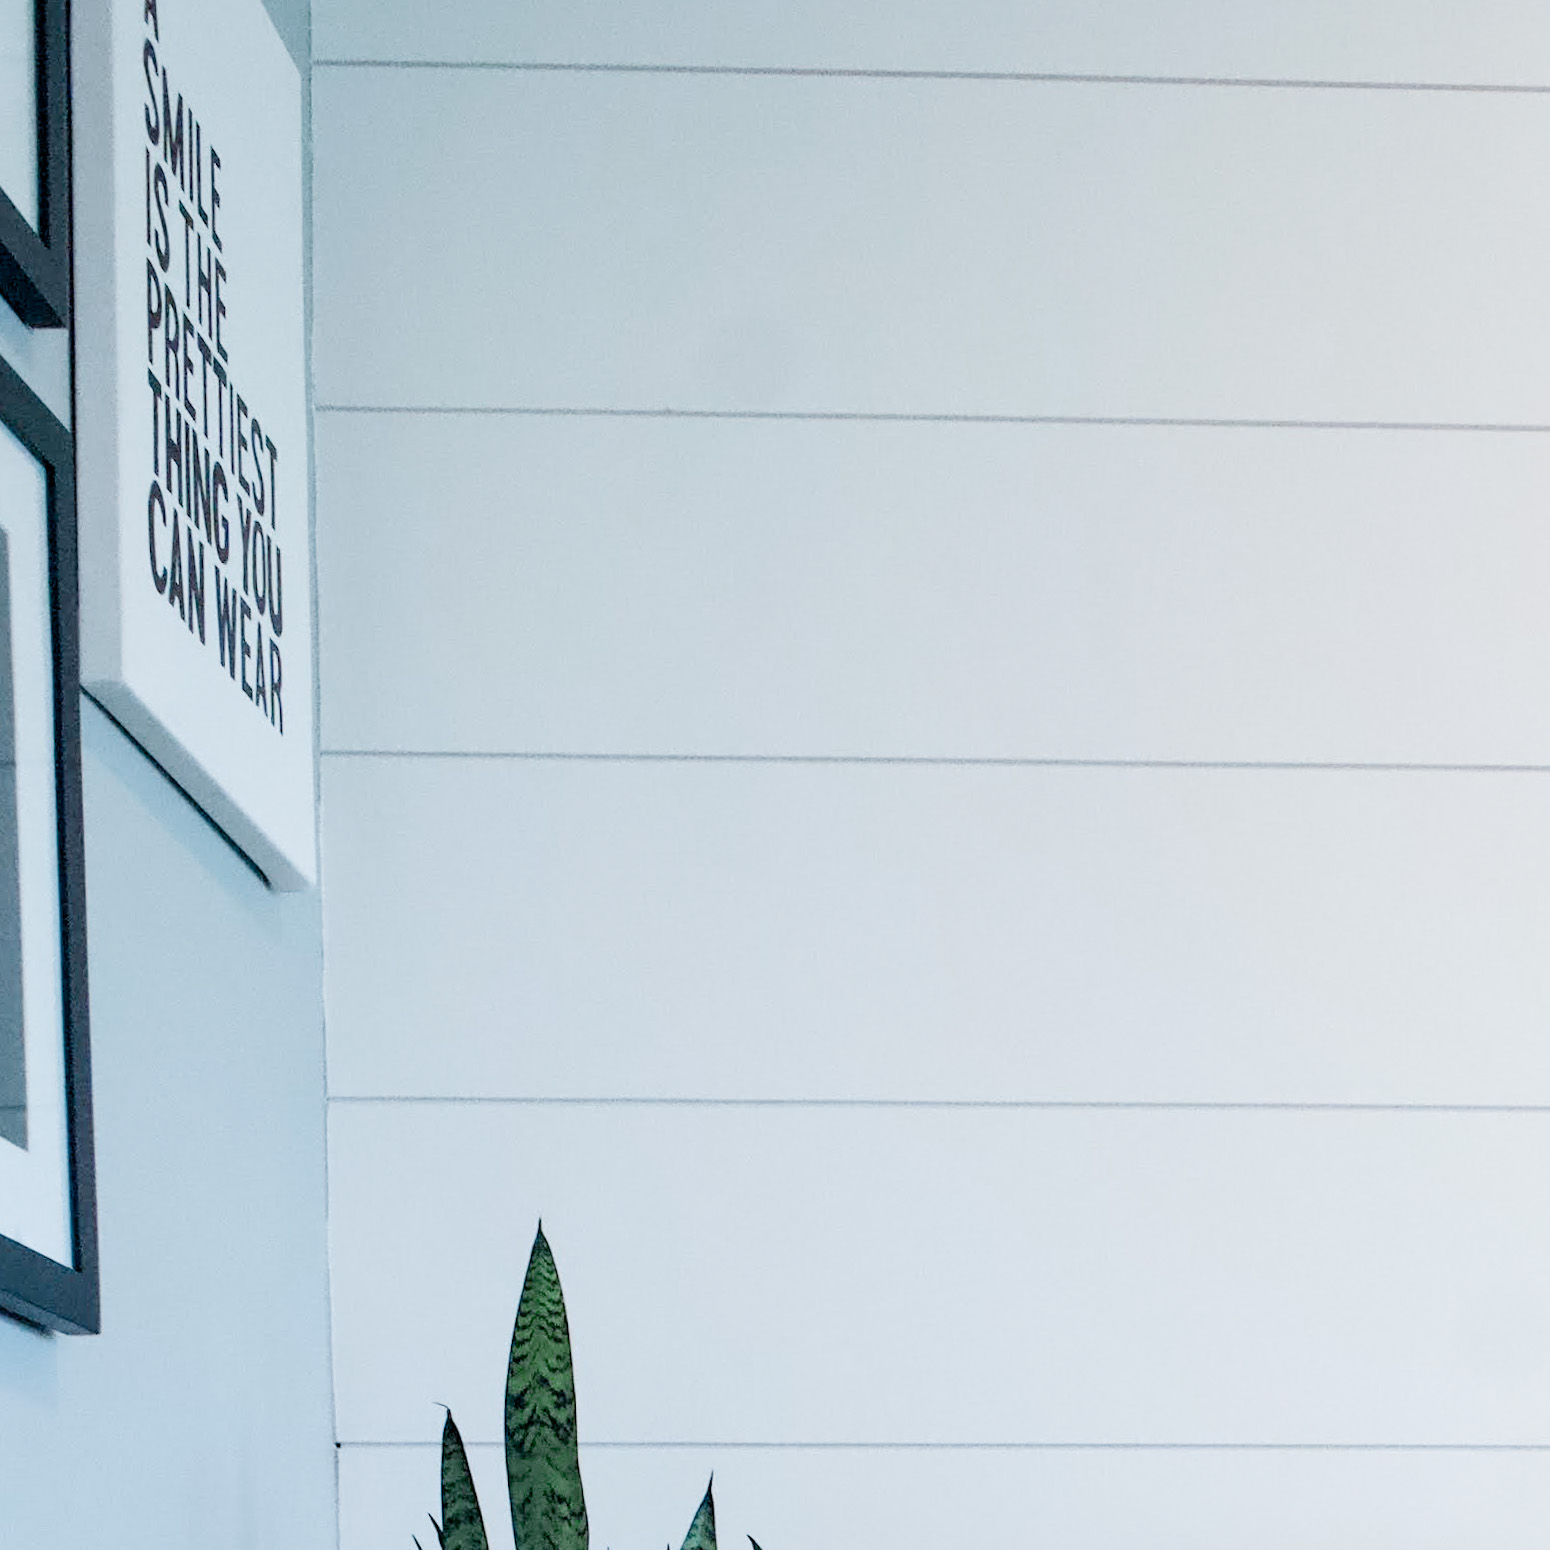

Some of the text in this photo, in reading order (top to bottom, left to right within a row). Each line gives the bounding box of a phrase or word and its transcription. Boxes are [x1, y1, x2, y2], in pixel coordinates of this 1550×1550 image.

[143, 37, 222, 253] SMILE
[146, 146, 228, 365] IS THE
[146, 257, 278, 530] PRETTIEST
[147, 367, 283, 637] THING YOU
[147, 479, 283, 736] CAN WEAR
